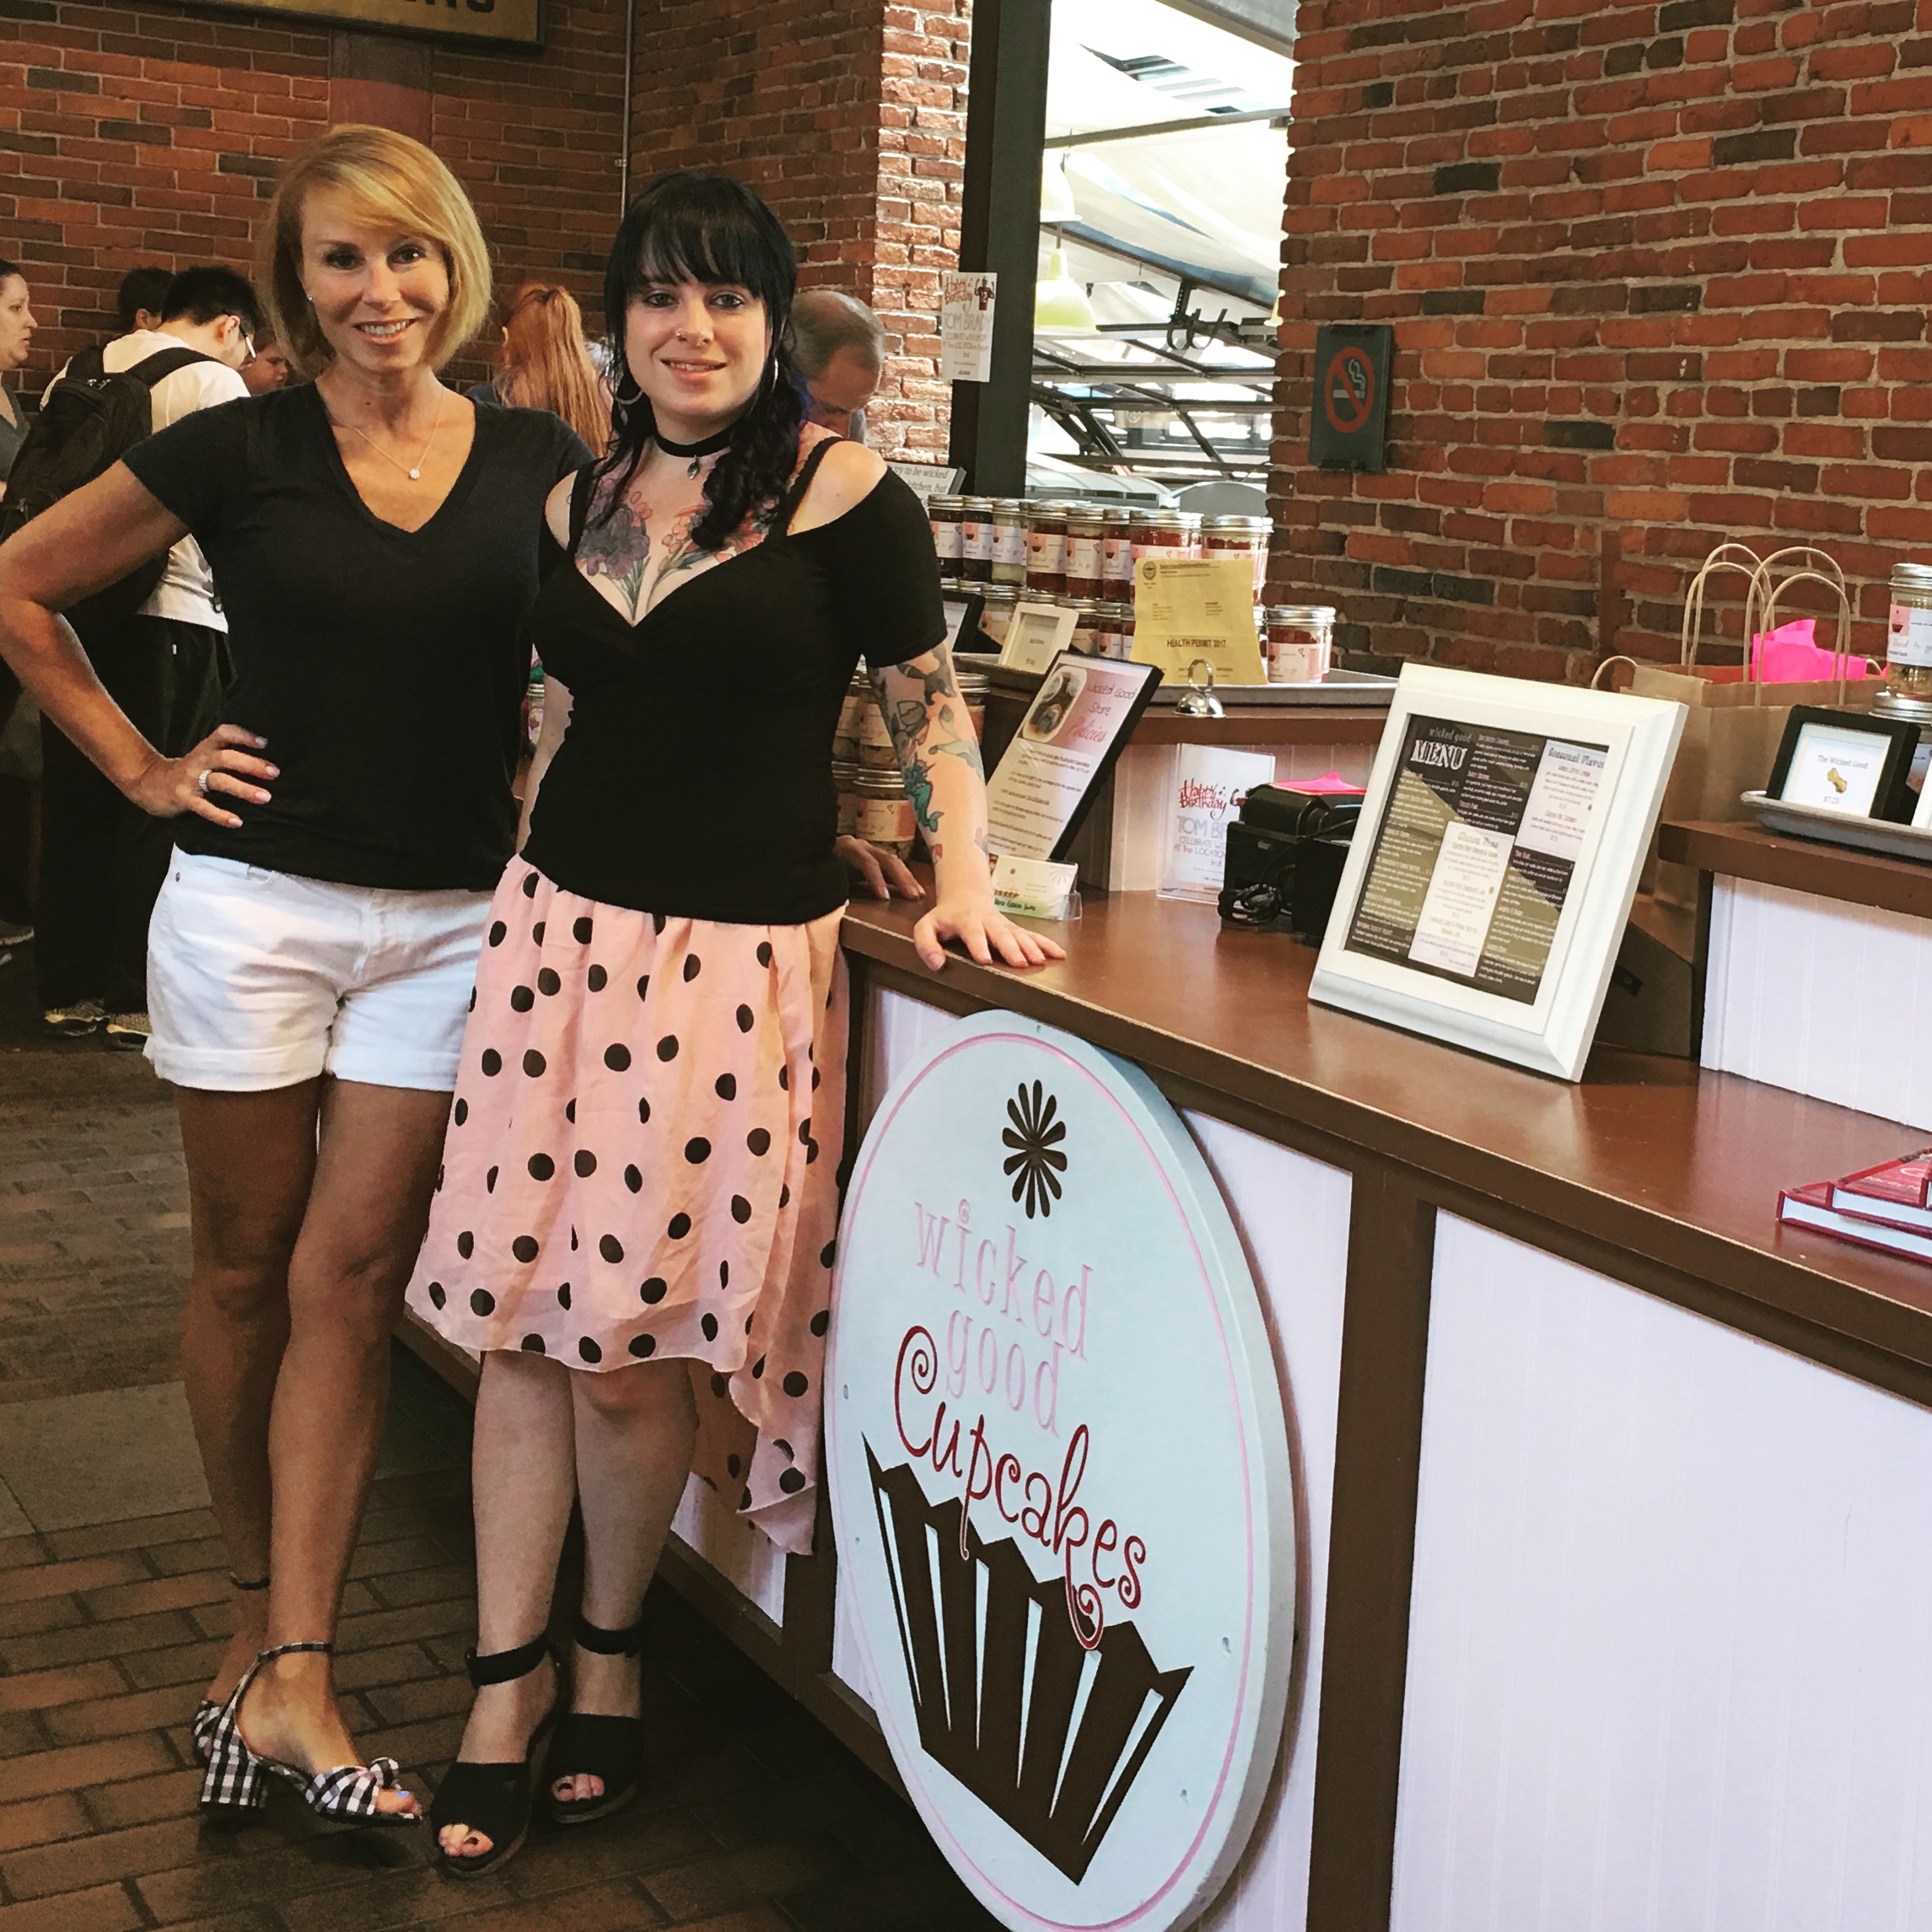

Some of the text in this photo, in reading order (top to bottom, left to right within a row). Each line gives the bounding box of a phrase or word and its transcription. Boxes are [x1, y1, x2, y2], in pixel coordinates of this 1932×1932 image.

[1166, 638, 1191, 648] HEALTH
[1191, 638, 1212, 648] PERMIT
[1114, 687, 1138, 699] Good
[1088, 701, 1112, 717] Store
[1067, 716, 1108, 743] Policies
[1429, 726, 1456, 740] wicked
[1409, 739, 1468, 771] MENU
[1816, 754, 1869, 769] The Wicked Good
[1178, 778, 1219, 800] Happy
[1178, 792, 1227, 821] Birthday
[1176, 815, 1208, 837] TOM
[1195, 847, 1225, 858] LOCATIO
[913, 1197, 1095, 1364] wicked
[944, 1309, 1066, 1440] good
[894, 1324, 1147, 1651] Cupcakes
